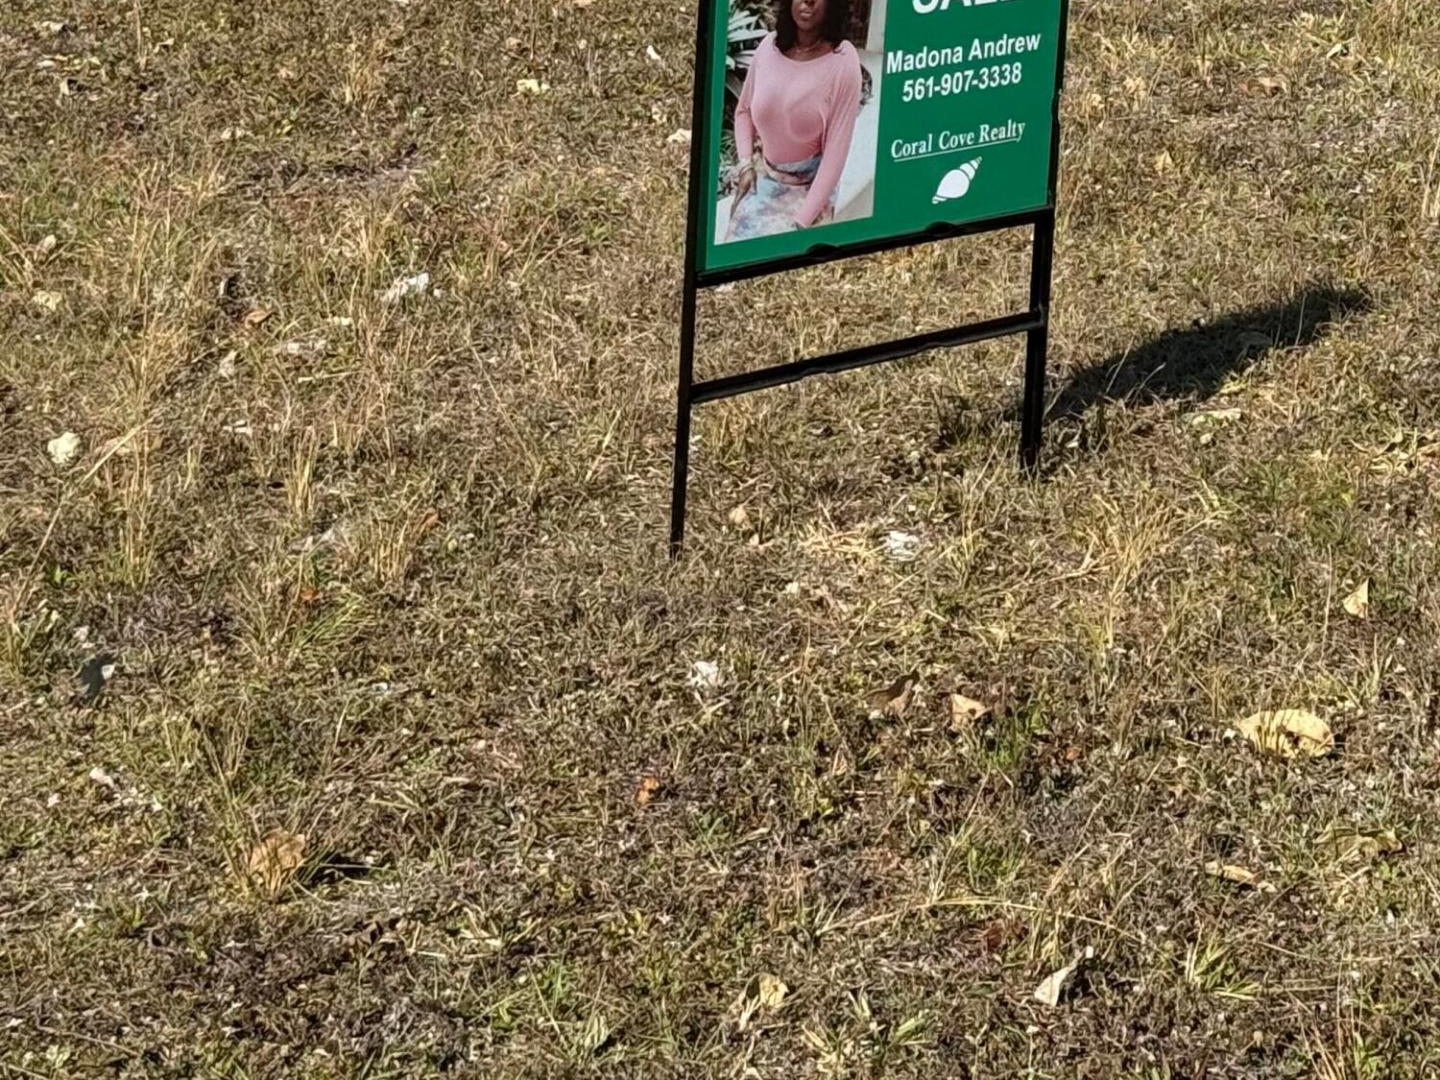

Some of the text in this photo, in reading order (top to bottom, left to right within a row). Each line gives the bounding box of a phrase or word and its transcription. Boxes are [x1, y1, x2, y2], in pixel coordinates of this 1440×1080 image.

[886, 33, 1041, 74] Madona Andrew
[902, 62, 1022, 102] 561-907-3338
[891, 119, 1026, 158] Coral Cove Realty
